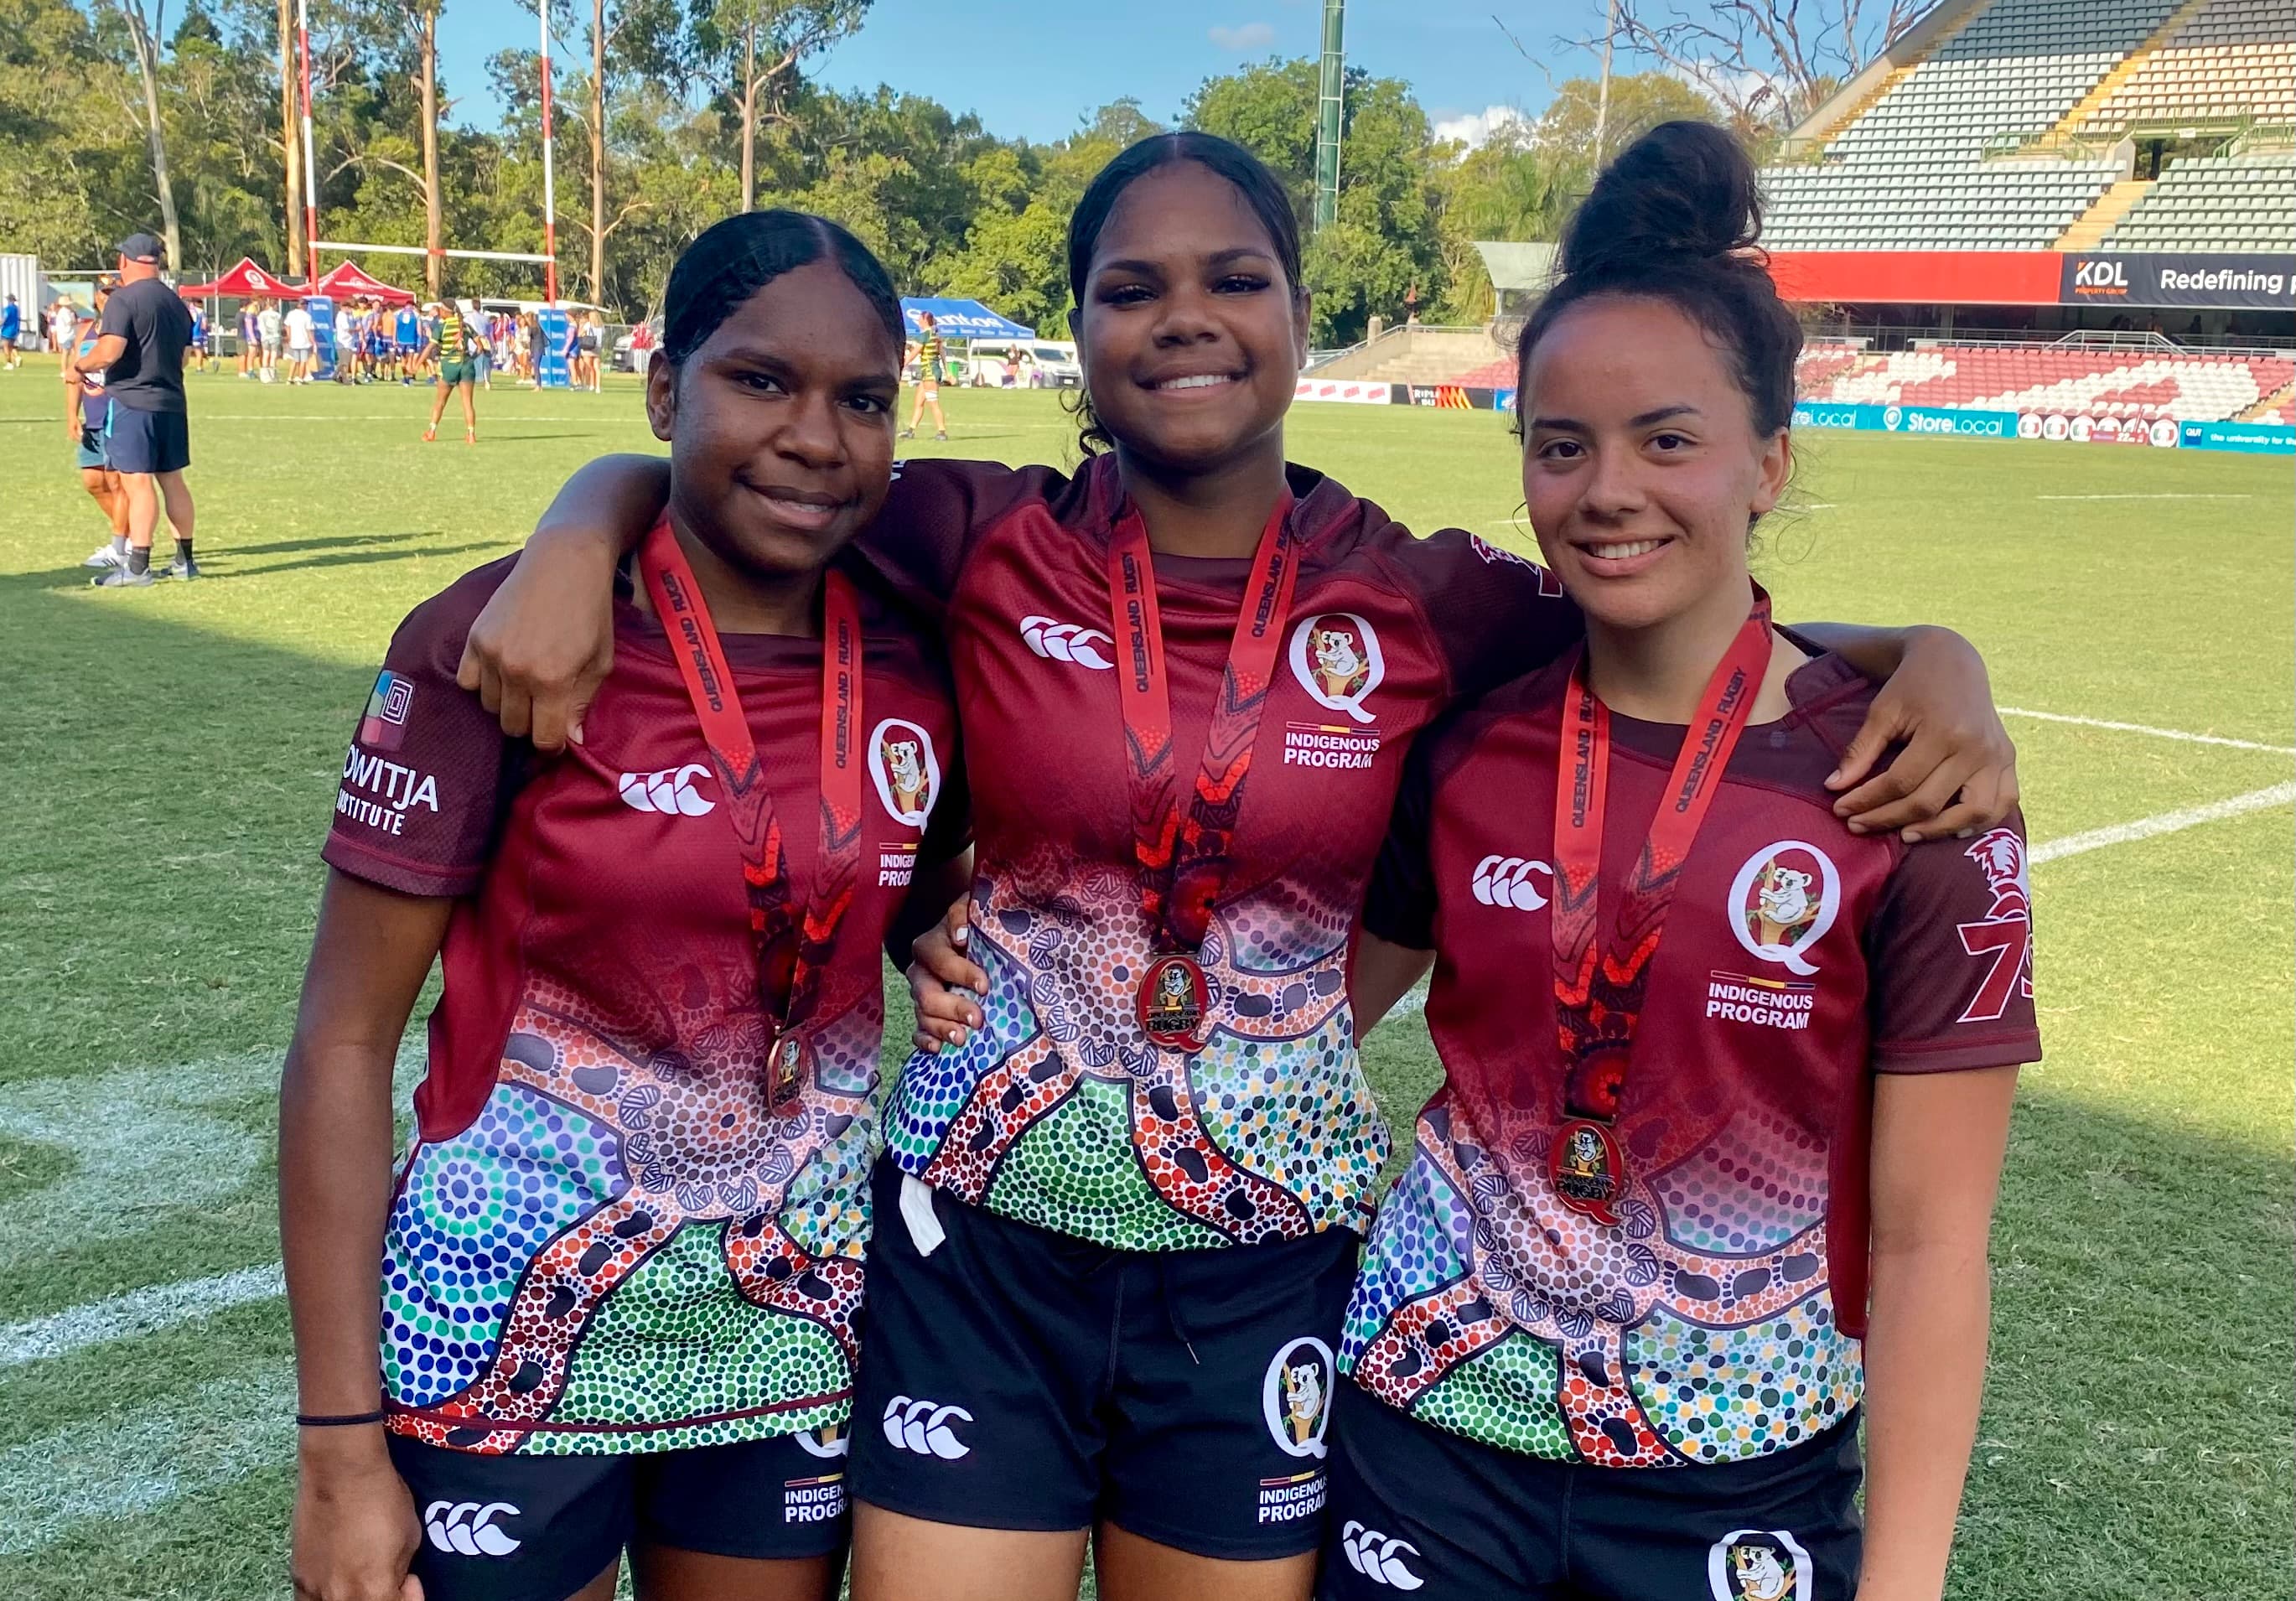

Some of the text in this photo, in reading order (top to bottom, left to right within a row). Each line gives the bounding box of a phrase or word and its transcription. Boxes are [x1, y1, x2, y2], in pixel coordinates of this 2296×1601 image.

[2076, 262, 2128, 286] KDL
[2161, 269, 2282, 293] Redefining
[906, 308, 1003, 329] Sntos
[1908, 412, 2003, 435] StoreLocal
[2210, 433, 2296, 445] the university for th
[1252, 554, 1283, 638] QUEENSLAND
[1127, 599, 1149, 693] QUEENSLAND
[680, 616, 723, 712] QUEENSLAND
[836, 671, 848, 769] QUEENSLAND
[1286, 733, 1381, 752] INDIGENOUS
[1676, 666, 1747, 813] QUEENSLAND RUGBY
[1283, 748, 1373, 769] PROGRAM
[342, 744, 438, 813] OWITJA
[1572, 728, 1591, 828] QUEENSLAND
[1708, 982, 1814, 1011] INDIGENOUS
[1706, 1001, 1811, 1031] PROGRAM
